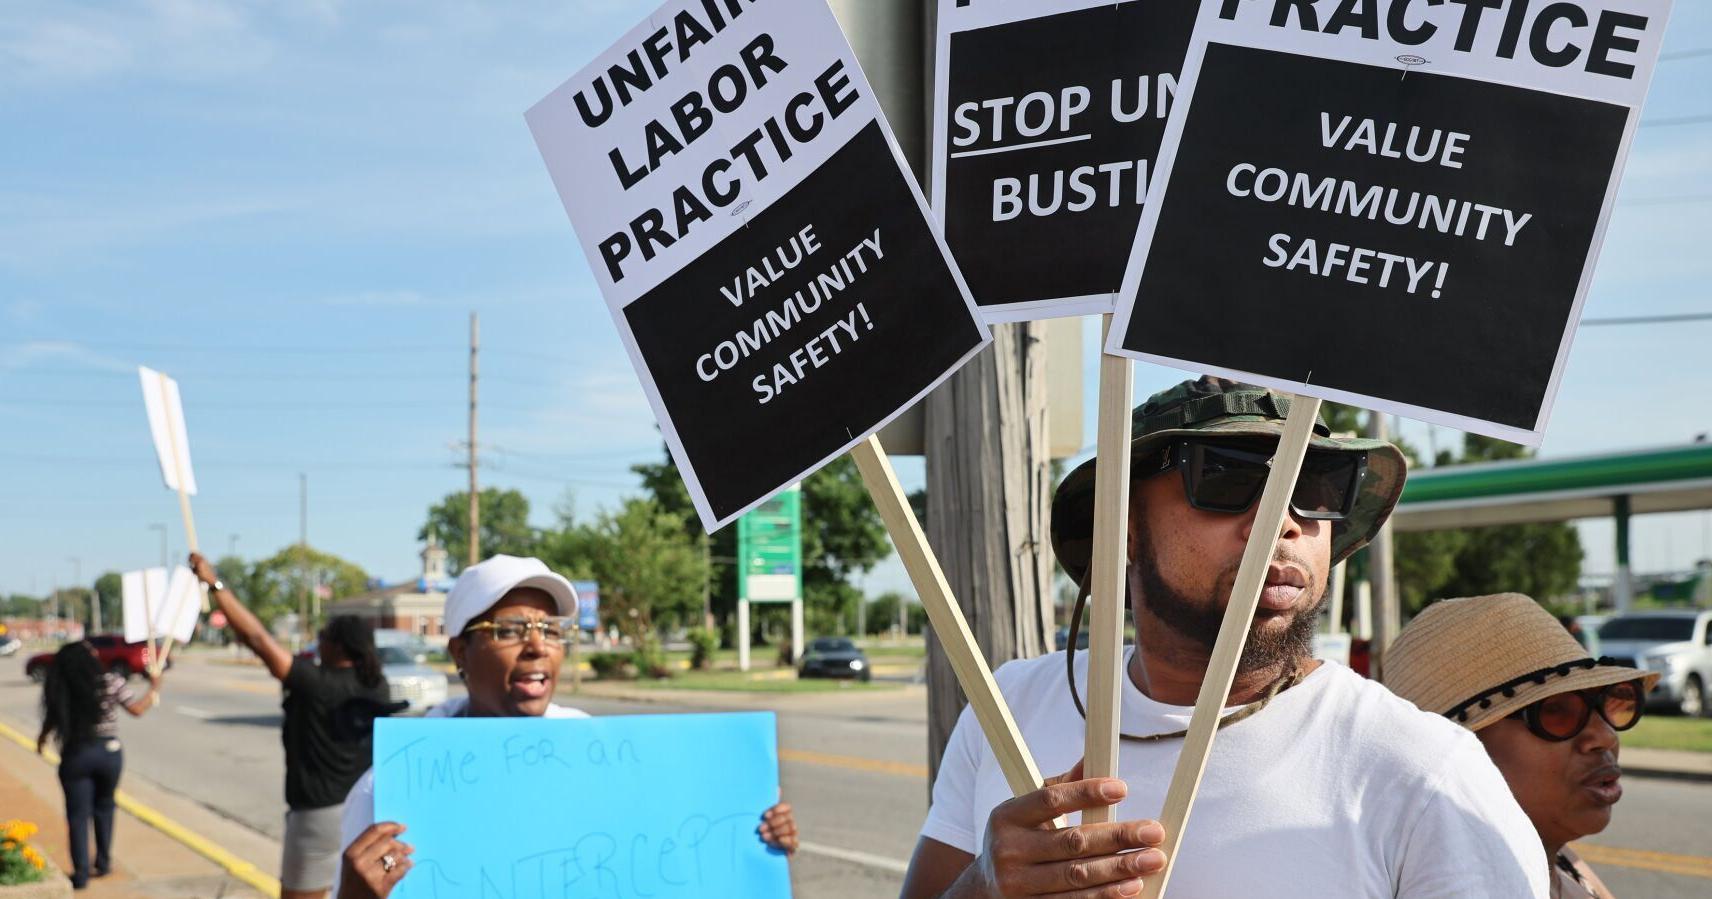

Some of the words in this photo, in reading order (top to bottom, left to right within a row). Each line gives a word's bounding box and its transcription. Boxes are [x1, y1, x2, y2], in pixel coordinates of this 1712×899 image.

[572, 0, 757, 128] UNFAI
[608, 33, 788, 191] LABOR
[953, 86, 1091, 147] STOP
[1319, 112, 1471, 169] VALUE
[598, 59, 860, 284] PRACTICE
[1226, 162, 1533, 248] COMMUNITY
[696, 228, 885, 383] COMMUNITY
[720, 224, 822, 308] VALUE
[1263, 233, 1450, 299] SAFETY!
[752, 302, 874, 405] SAFETY!
[504, 735, 571, 774] FOR
